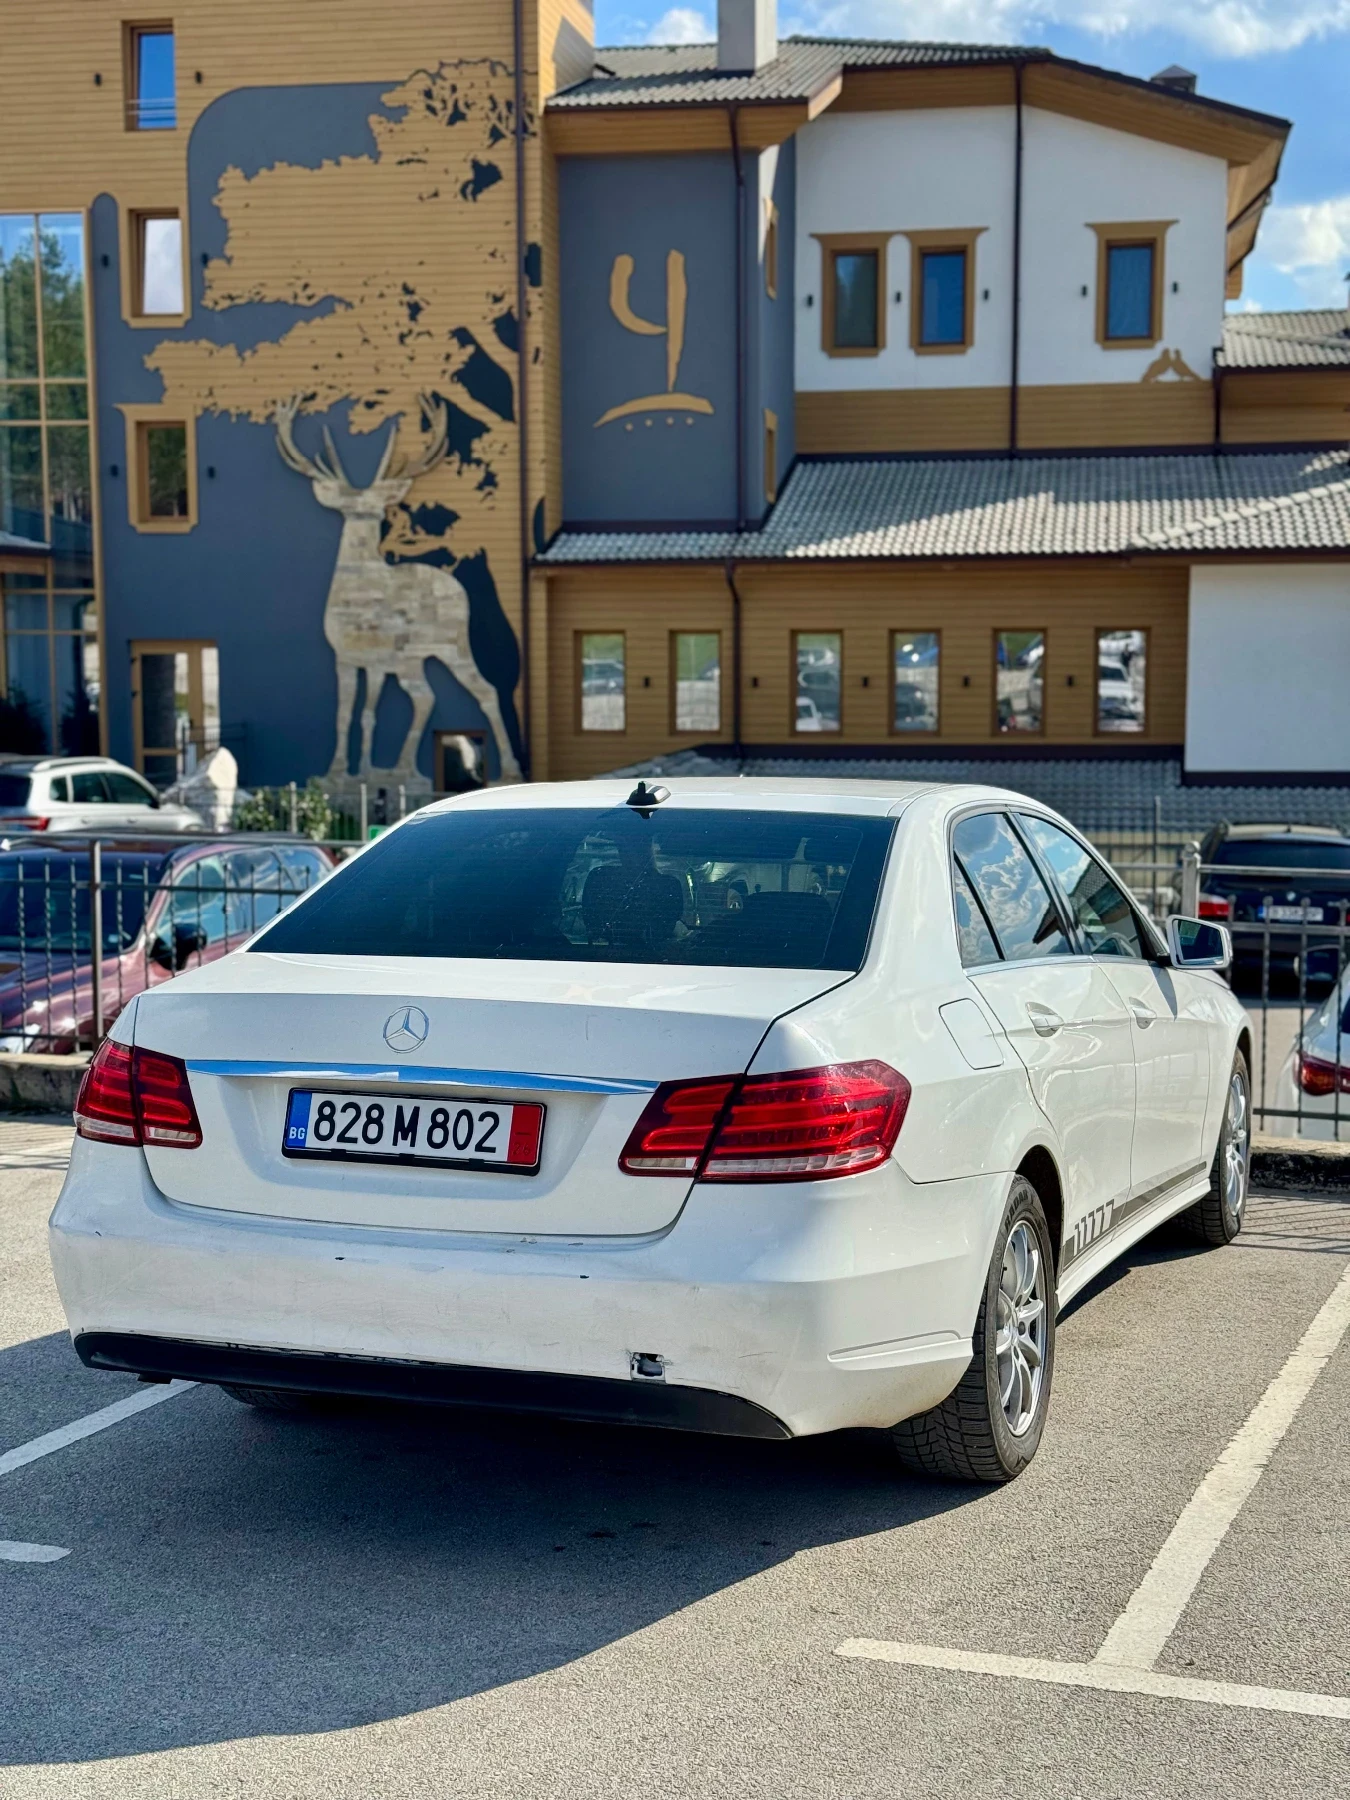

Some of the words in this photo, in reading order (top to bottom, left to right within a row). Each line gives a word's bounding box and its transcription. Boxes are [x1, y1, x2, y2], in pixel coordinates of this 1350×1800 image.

[289, 1126, 306, 1140] BG
[313, 1100, 385, 1145] 828
[392, 1105, 420, 1148] M
[426, 1107, 500, 1154] 802
